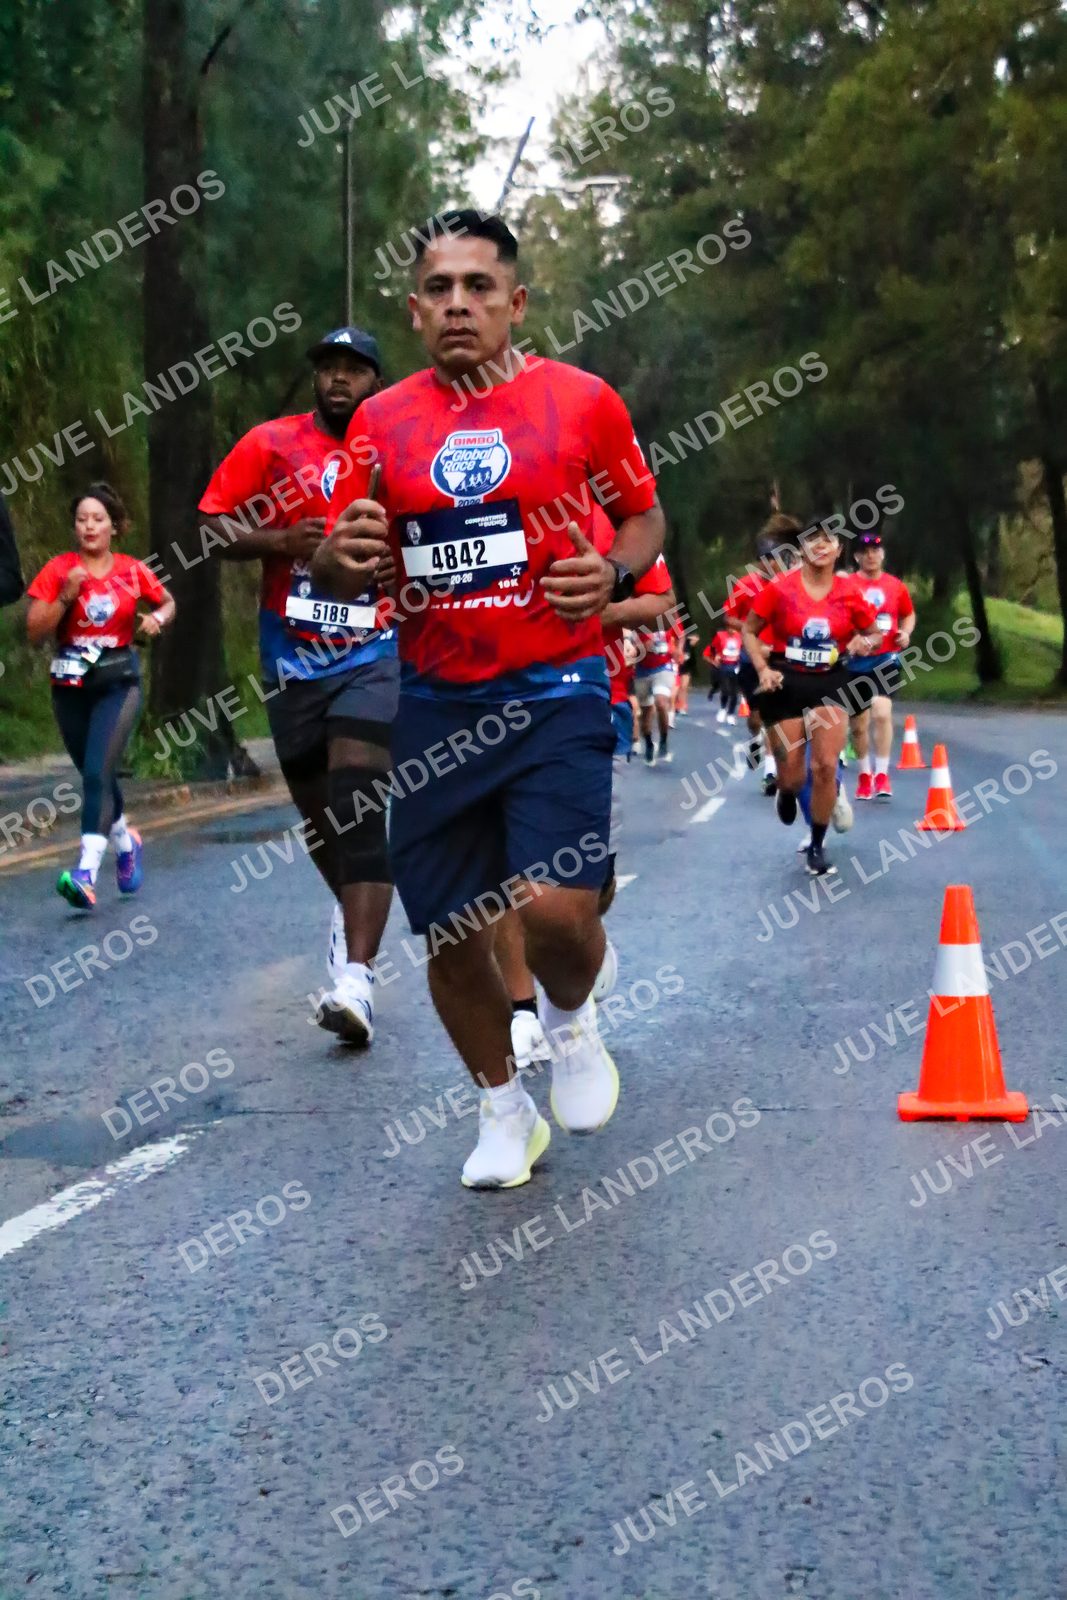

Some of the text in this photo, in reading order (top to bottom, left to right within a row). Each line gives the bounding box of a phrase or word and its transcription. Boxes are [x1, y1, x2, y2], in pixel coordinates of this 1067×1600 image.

[454, 436, 495, 446] BIMBO
[452, 448, 493, 462] Global
[443, 460, 476, 472] Race
[432, 539, 488, 571] 4842
[497, 578, 519, 589] 10K
[312, 603, 349, 624] 5189
